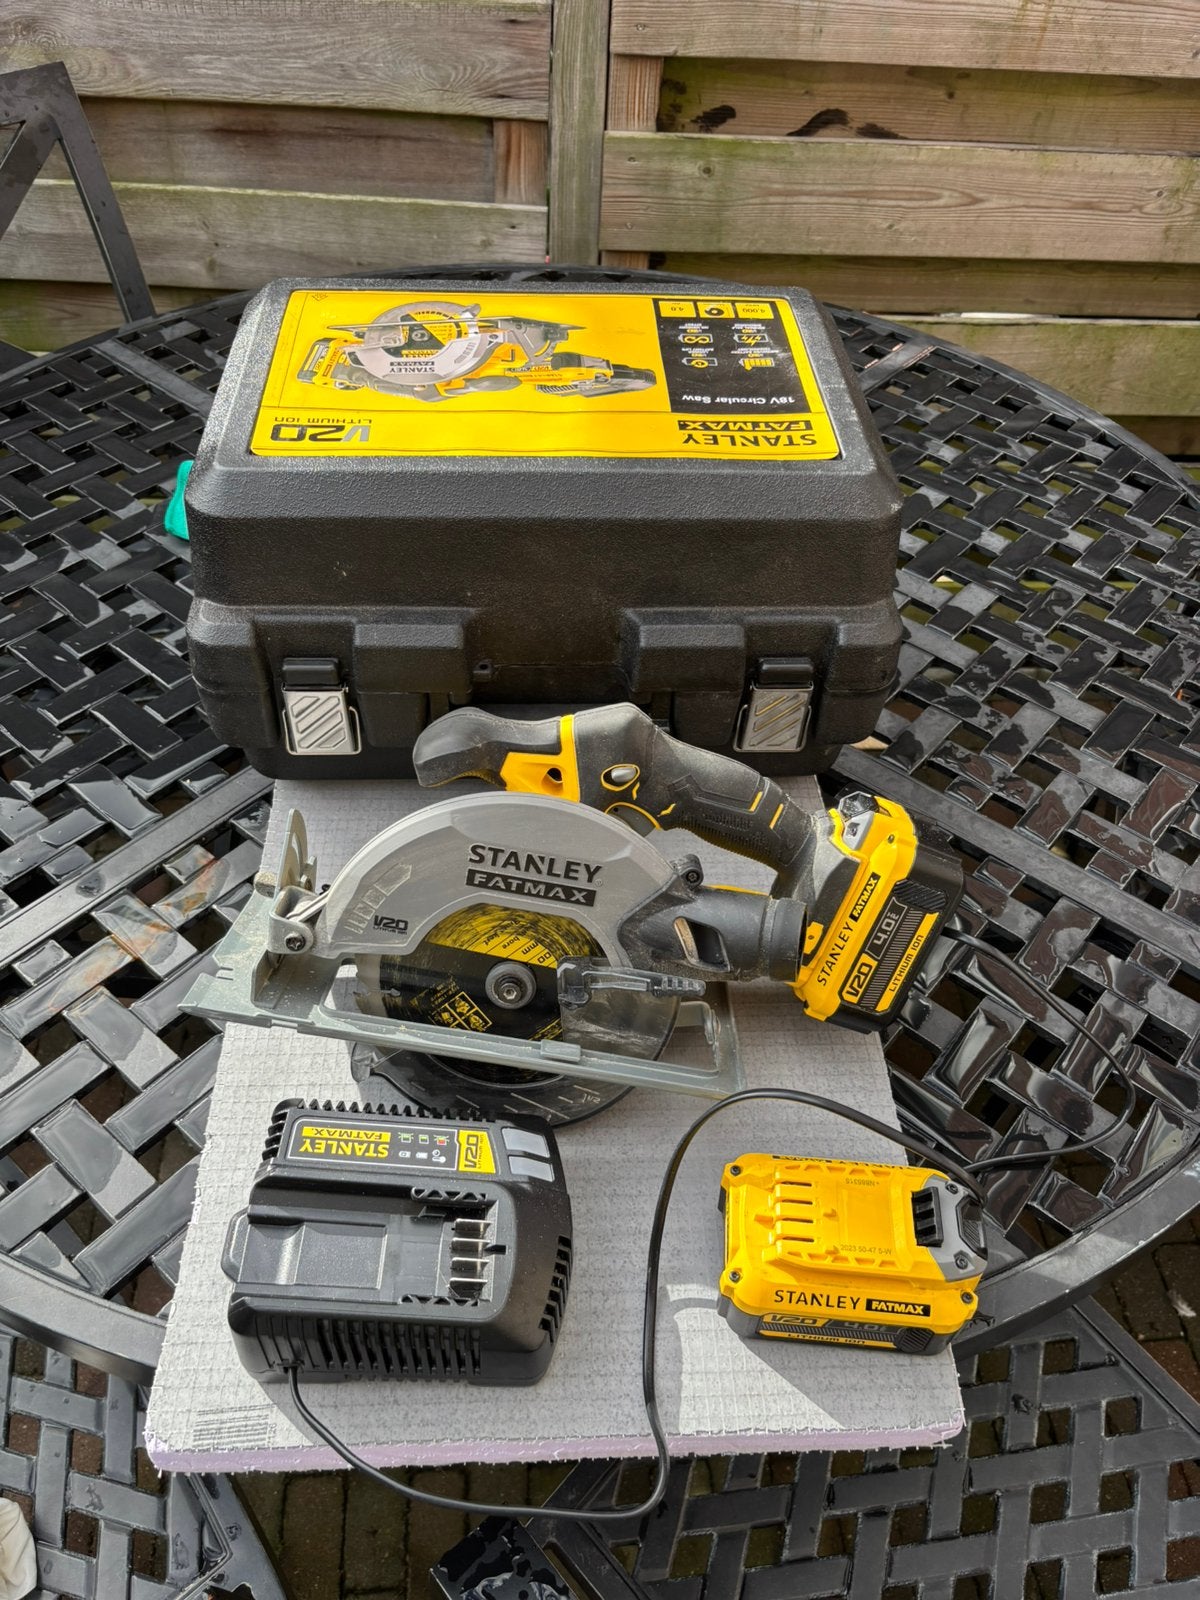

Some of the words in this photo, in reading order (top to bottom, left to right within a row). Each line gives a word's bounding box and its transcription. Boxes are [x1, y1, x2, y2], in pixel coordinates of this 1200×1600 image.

[682, 394, 711, 404] Saw
[716, 396, 766, 404] Circular
[770, 396, 796, 404] 18V
[270, 424, 370, 442] V20
[682, 433, 817, 447] STANLEY
[468, 844, 602, 884] STANLEY
[473, 873, 588, 904] FATMAX
[374, 915, 408, 930] V20
[817, 920, 854, 986] STANLEY
[853, 876, 878, 917] FATMAX
[502, 936, 520, 950] bore
[846, 961, 873, 998] V20
[889, 953, 914, 992] LITHIUM
[300, 1138, 389, 1158] STANLEY
[464, 1134, 478, 1168] V20
[774, 1290, 861, 1310] STANLEY
[871, 1300, 924, 1315] FATMAX
[771, 1314, 817, 1326] V20
[788, 1333, 840, 1342] LITHIUM
